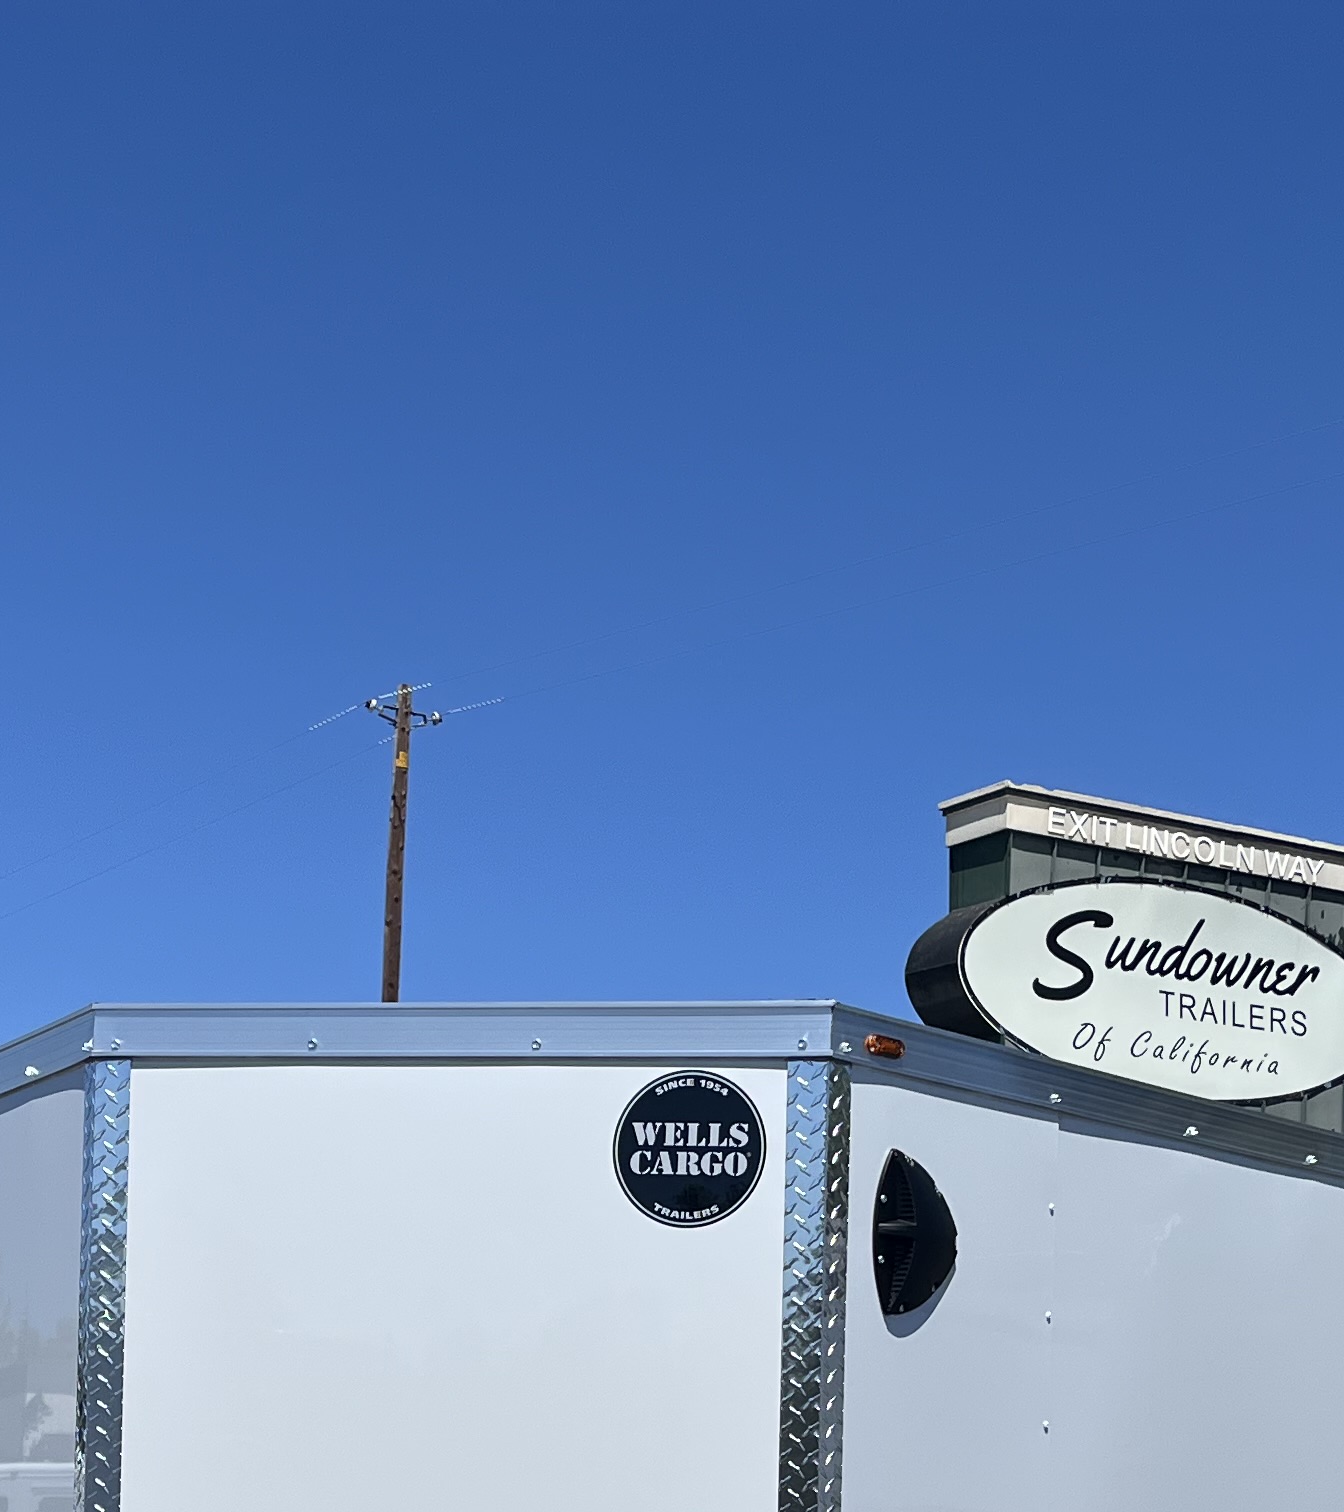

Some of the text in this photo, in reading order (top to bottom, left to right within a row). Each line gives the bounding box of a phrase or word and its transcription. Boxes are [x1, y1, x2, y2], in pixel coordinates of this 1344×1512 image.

[1047, 806, 1325, 885] EXIT LINCOLN WAY
[1032, 909, 1320, 1001] Sundowner
[1158, 989, 1308, 1037] TRAILERS
[1072, 1022, 1280, 1075] Of California
[655, 1078, 729, 1097] SINCE 1954
[631, 1121, 750, 1148] WELLS
[629, 1150, 749, 1177] CARGO
[653, 1202, 720, 1220] TRAILERS
